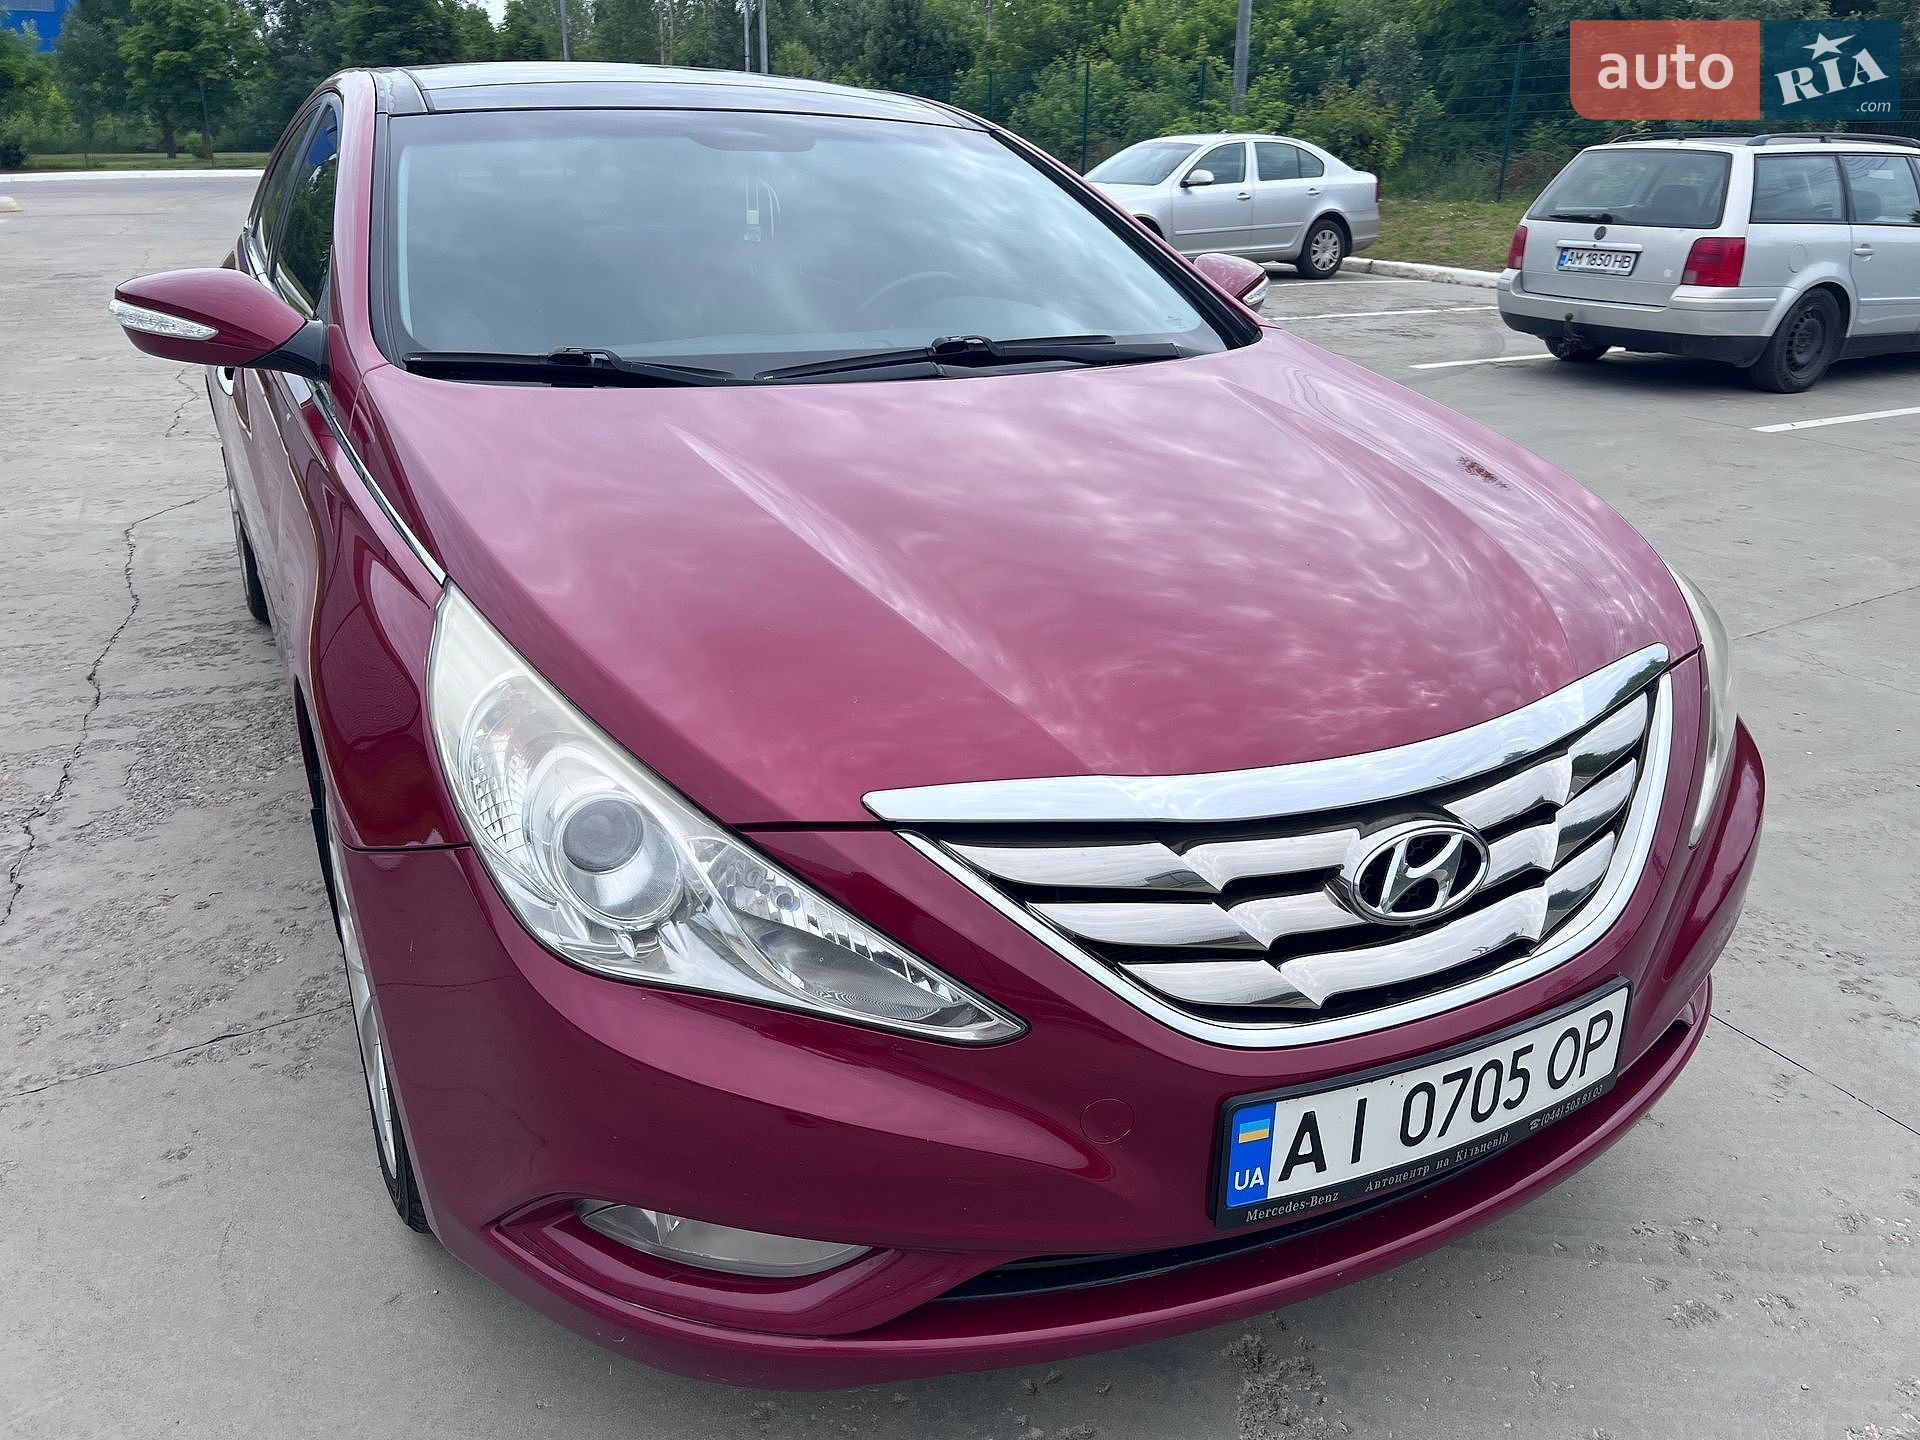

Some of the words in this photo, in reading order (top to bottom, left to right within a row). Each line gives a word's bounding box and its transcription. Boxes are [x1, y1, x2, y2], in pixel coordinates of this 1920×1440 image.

[1565, 251, 1584, 265] AM
[1586, 253, 1612, 267] 1850
[1612, 254, 1632, 269] HB
[1278, 1097, 1367, 1182] AI
[1399, 1043, 1534, 1148] 0705
[1547, 1009, 1614, 1090] OP
[1234, 1166, 1265, 1191] UA
[1245, 1192, 1339, 1222] Mercedes-Benz
[1364, 1164, 1430, 1193] Автоцентр
[1436, 1156, 1450, 1170] на
[1541, 1105, 1564, 1127] (044)
